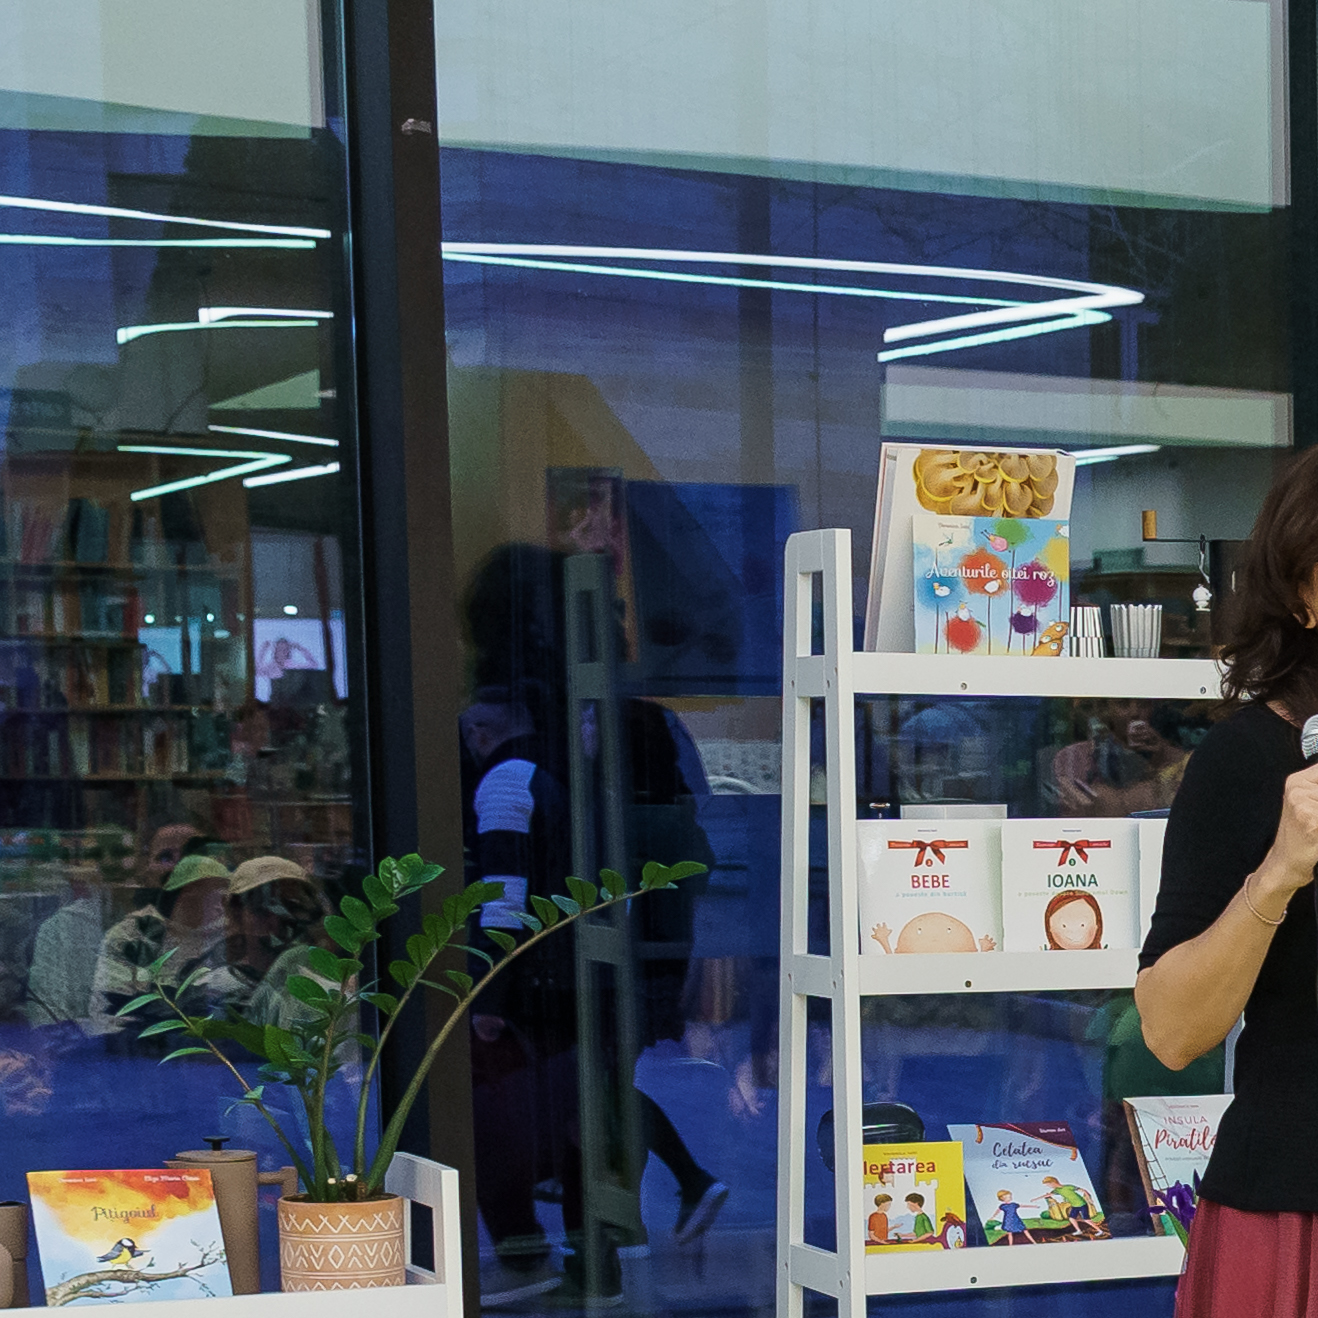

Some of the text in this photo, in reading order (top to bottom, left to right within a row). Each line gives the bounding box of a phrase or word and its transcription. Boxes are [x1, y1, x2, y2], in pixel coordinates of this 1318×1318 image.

[926, 562, 999, 579] Aventurile
[1032, 569, 1055, 587] roz
[911, 874, 950, 889] BEBE
[1047, 873, 1099, 889] IOANA
[1164, 1115, 1207, 1125] INSULA
[993, 1141, 1043, 1158] Cetatea
